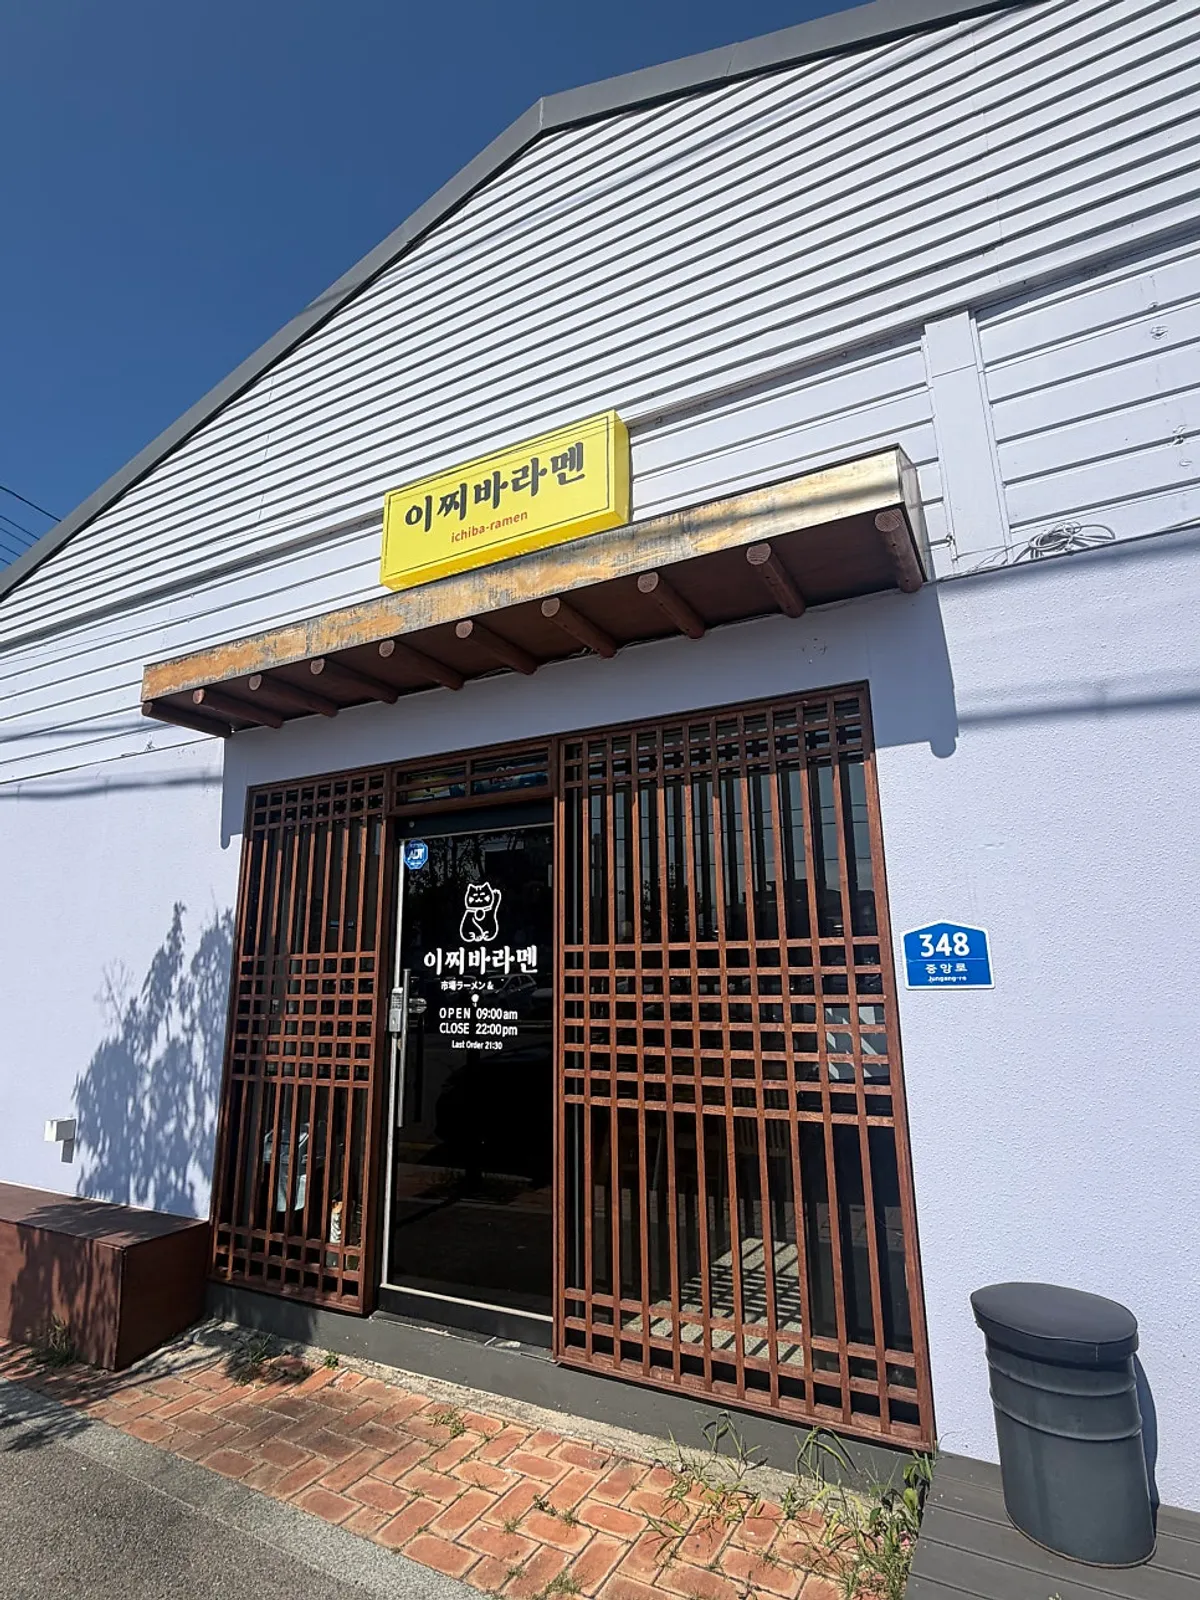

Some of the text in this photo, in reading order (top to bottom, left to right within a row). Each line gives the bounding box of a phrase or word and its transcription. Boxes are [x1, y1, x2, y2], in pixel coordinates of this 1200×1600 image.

[405, 442, 586, 532] 이찌바라멘
[451, 510, 528, 543] ichiba-ramen
[407, 848, 425, 860] ADT
[919, 932, 970, 958] 348
[424, 945, 538, 975] 이찌바라멘
[439, 1007, 471, 1019] OPEN
[439, 1022, 470, 1034] CLOSE
[451, 1040, 503, 1050] Last Order 21:30
